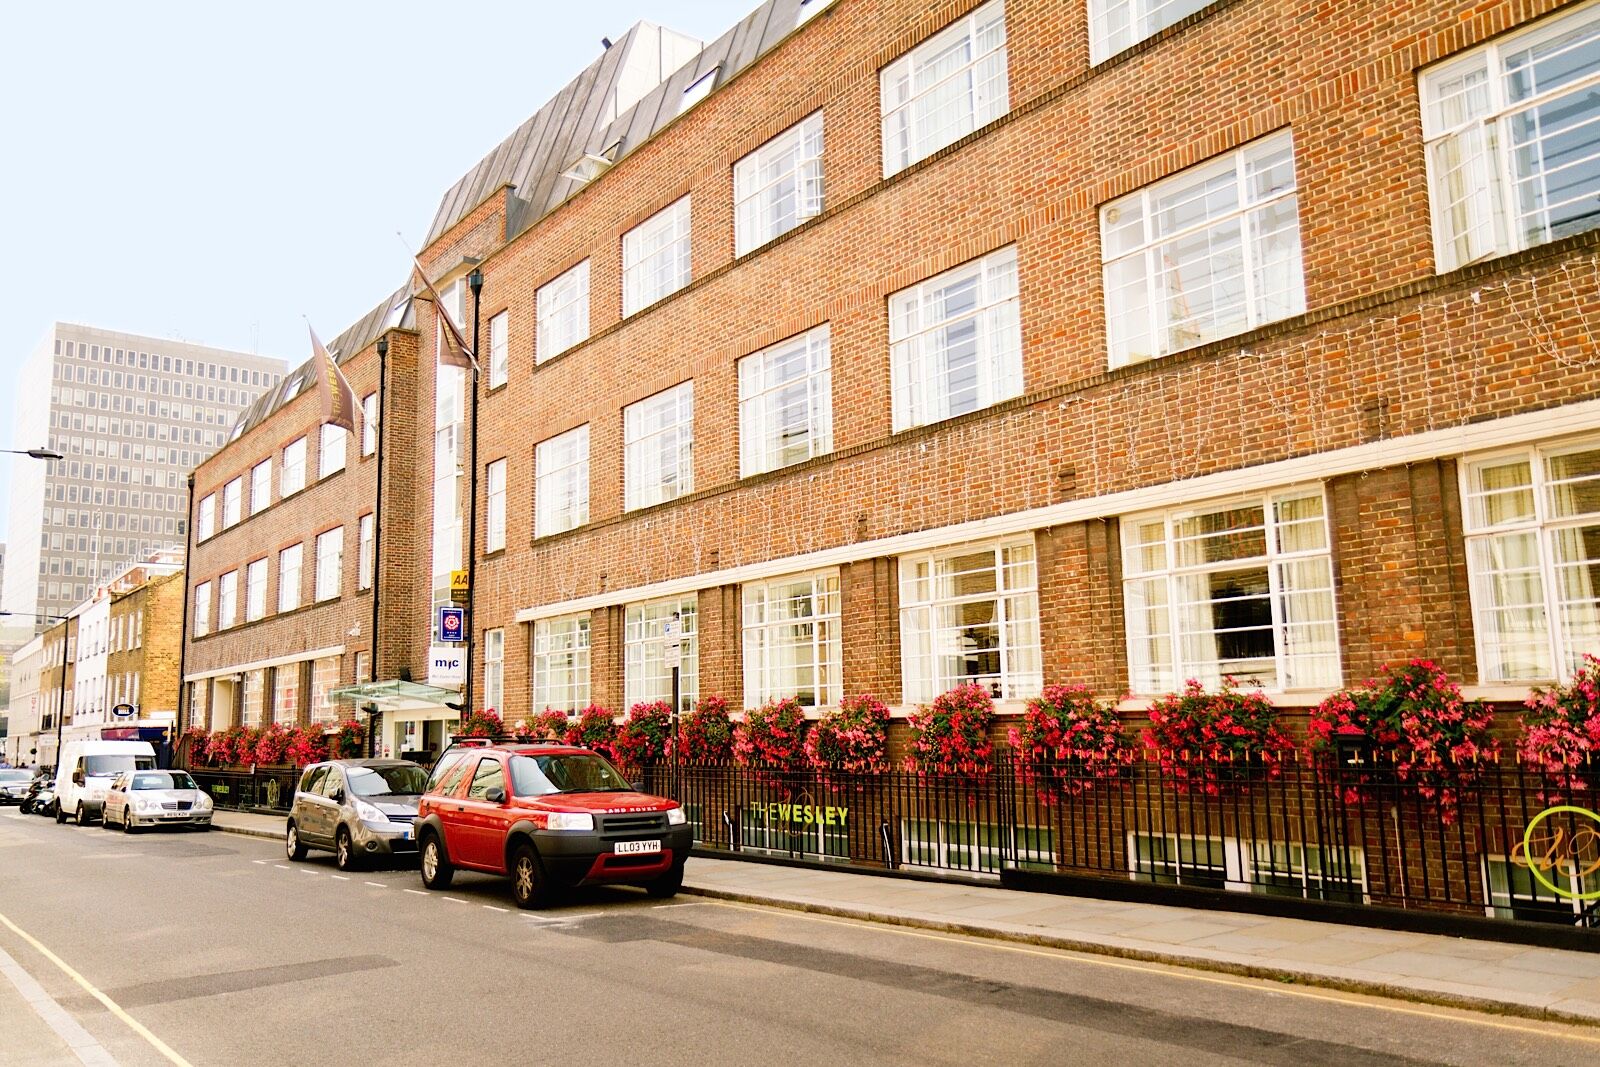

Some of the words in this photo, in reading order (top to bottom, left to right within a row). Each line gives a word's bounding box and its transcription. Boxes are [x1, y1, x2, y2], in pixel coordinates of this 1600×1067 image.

[453, 574, 468, 585] AA
[630, 805, 658, 813] ROVER
[618, 843, 641, 853] LL03
[642, 841, 658, 851] YYH
